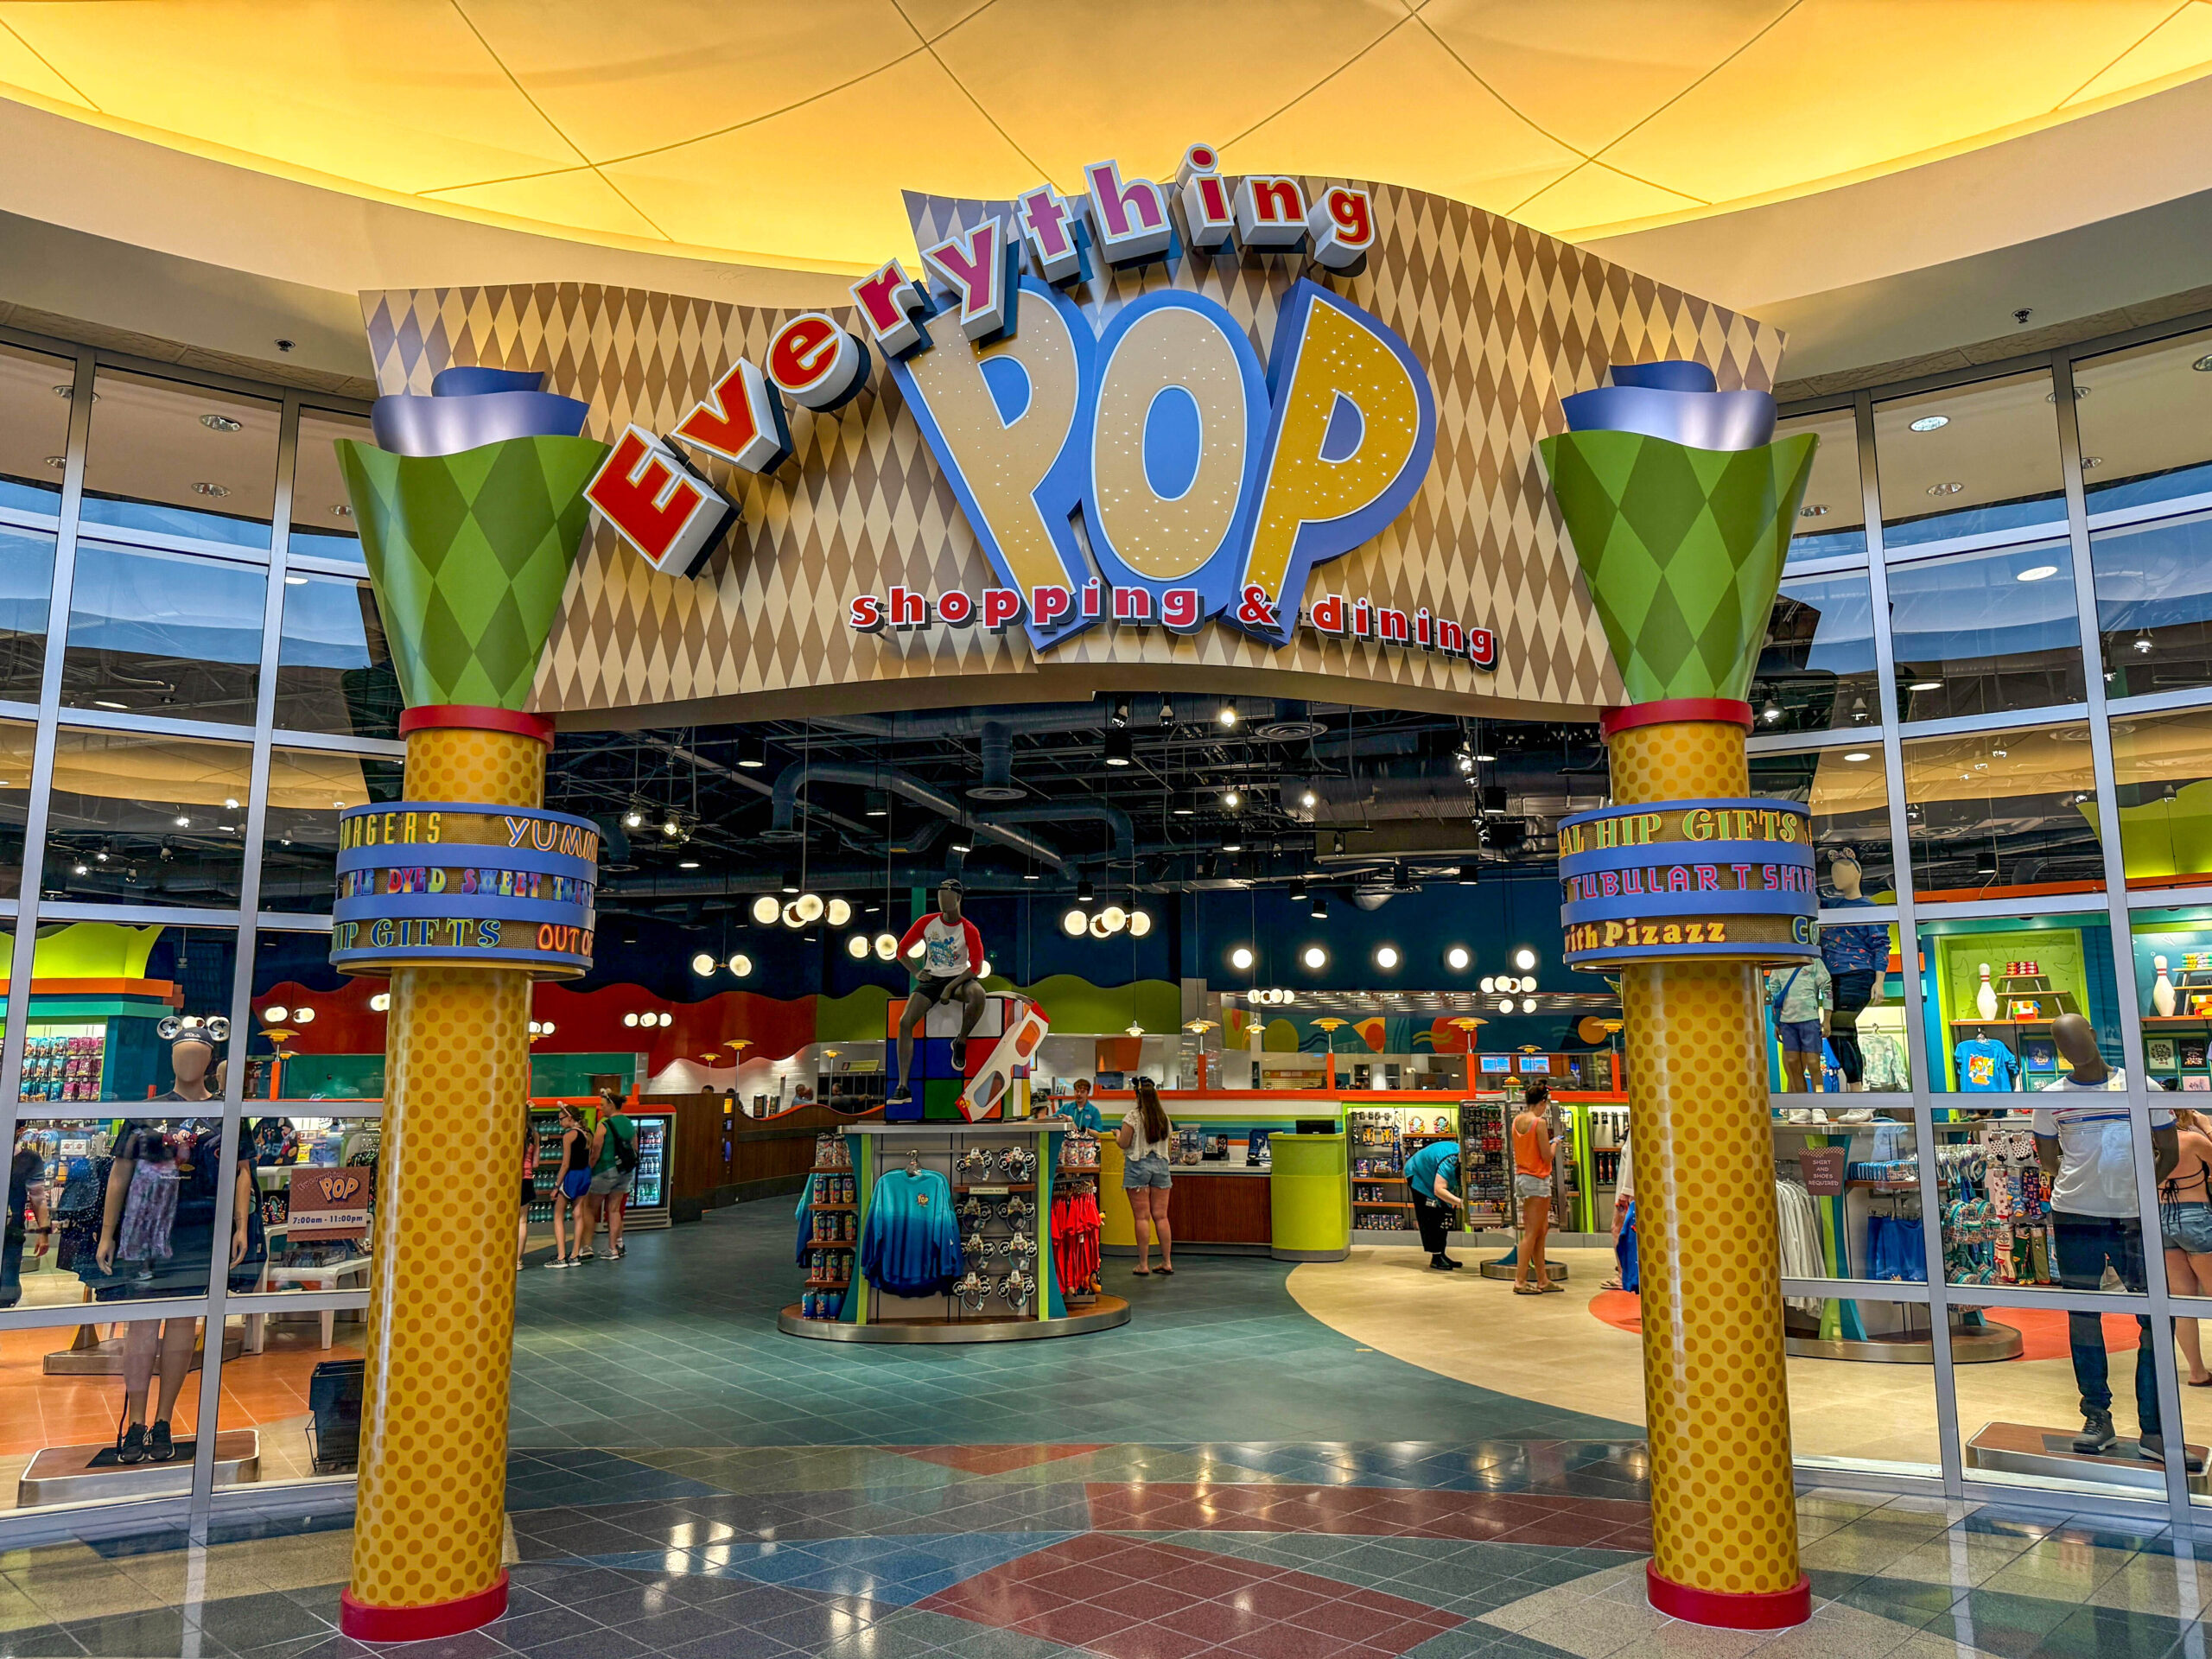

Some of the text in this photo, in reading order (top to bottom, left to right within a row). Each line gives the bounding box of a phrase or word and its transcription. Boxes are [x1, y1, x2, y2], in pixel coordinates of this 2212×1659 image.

[582, 143, 1376, 575] Everything
[903, 288, 1422, 607] POP
[849, 576, 1498, 671] shopping & dining
[505, 816, 598, 863] YUMM
[1557, 824, 1584, 858] AL
[1595, 814, 1662, 849] HIP
[1682, 809, 1797, 842] GIFTS
[348, 868, 375, 897] TIE
[387, 868, 447, 893] DYED
[461, 868, 542, 899] SWEET
[1571, 864, 1815, 900] TUBULAR T SHIR
[371, 918, 500, 948] GIFTS
[537, 923, 581, 954] OUT
[1603, 918, 1726, 947] Pizazz
[319, 1177, 359, 1202] POP
[330, 1215, 363, 1224] 11:00pm
